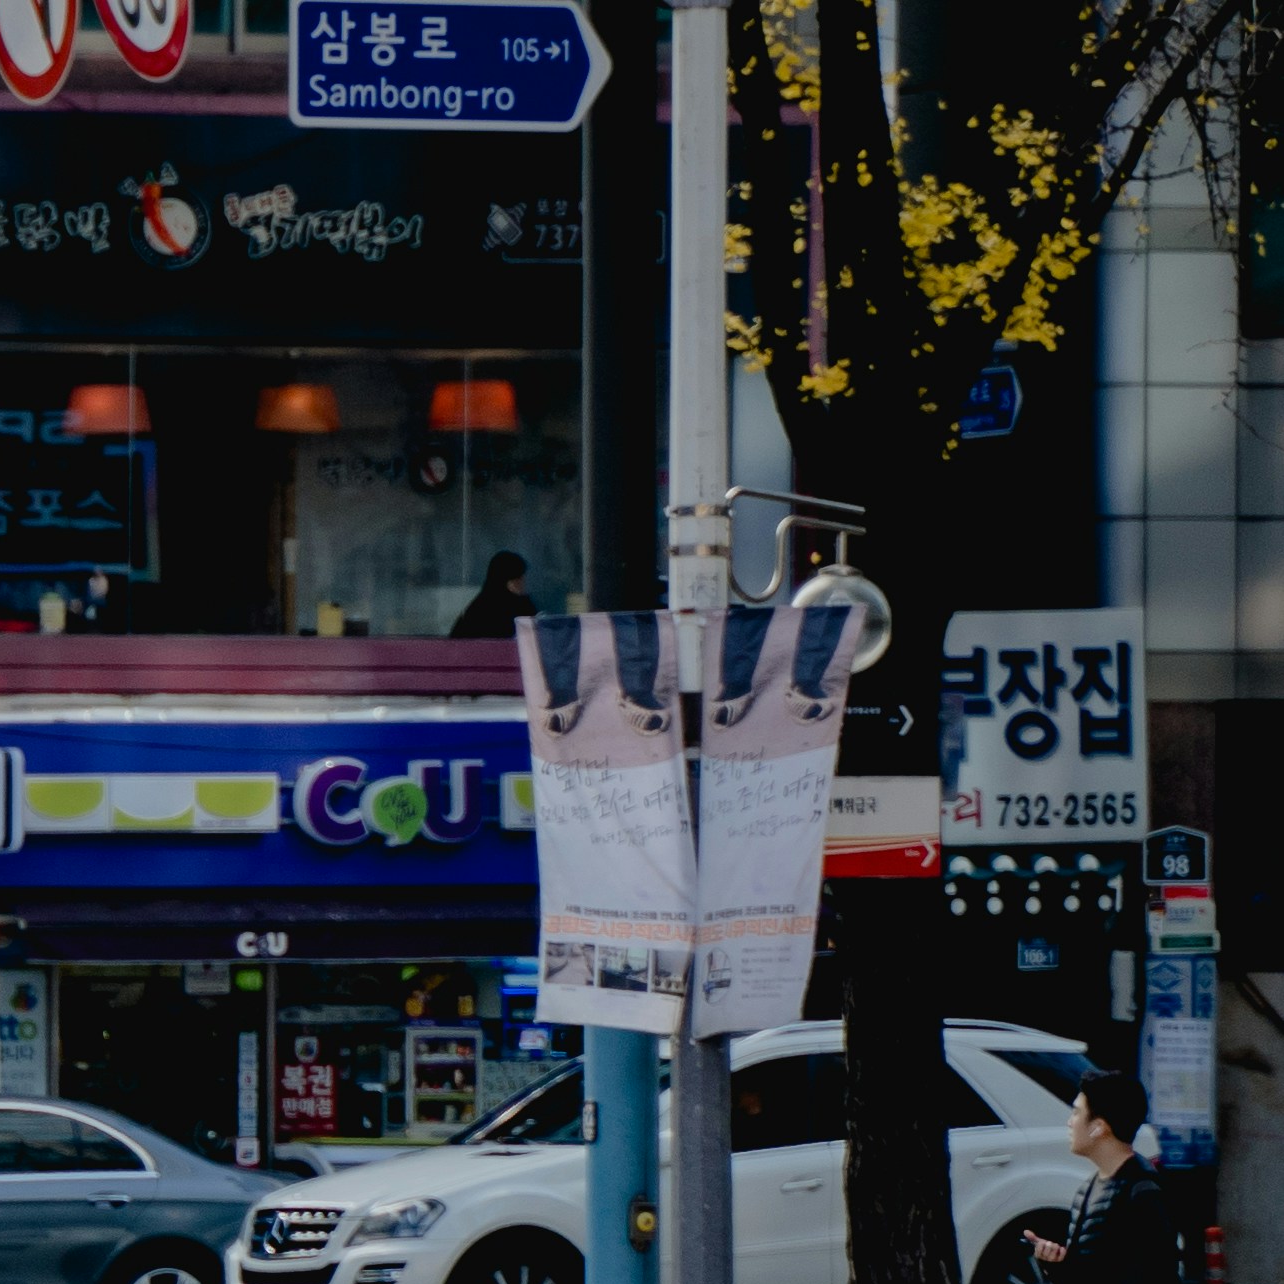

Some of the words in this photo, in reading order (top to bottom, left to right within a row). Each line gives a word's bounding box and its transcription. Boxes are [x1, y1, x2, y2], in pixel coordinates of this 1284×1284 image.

[310, 10, 457, 67] 삼봉로
[501, 38, 540, 62] 105
[309, 74, 515, 117] Sambong-ro
[996, 792, 1137, 827] 732-2565
[1162, 854, 1191, 878] 98
[281, 1065, 333, 1097] 복권
